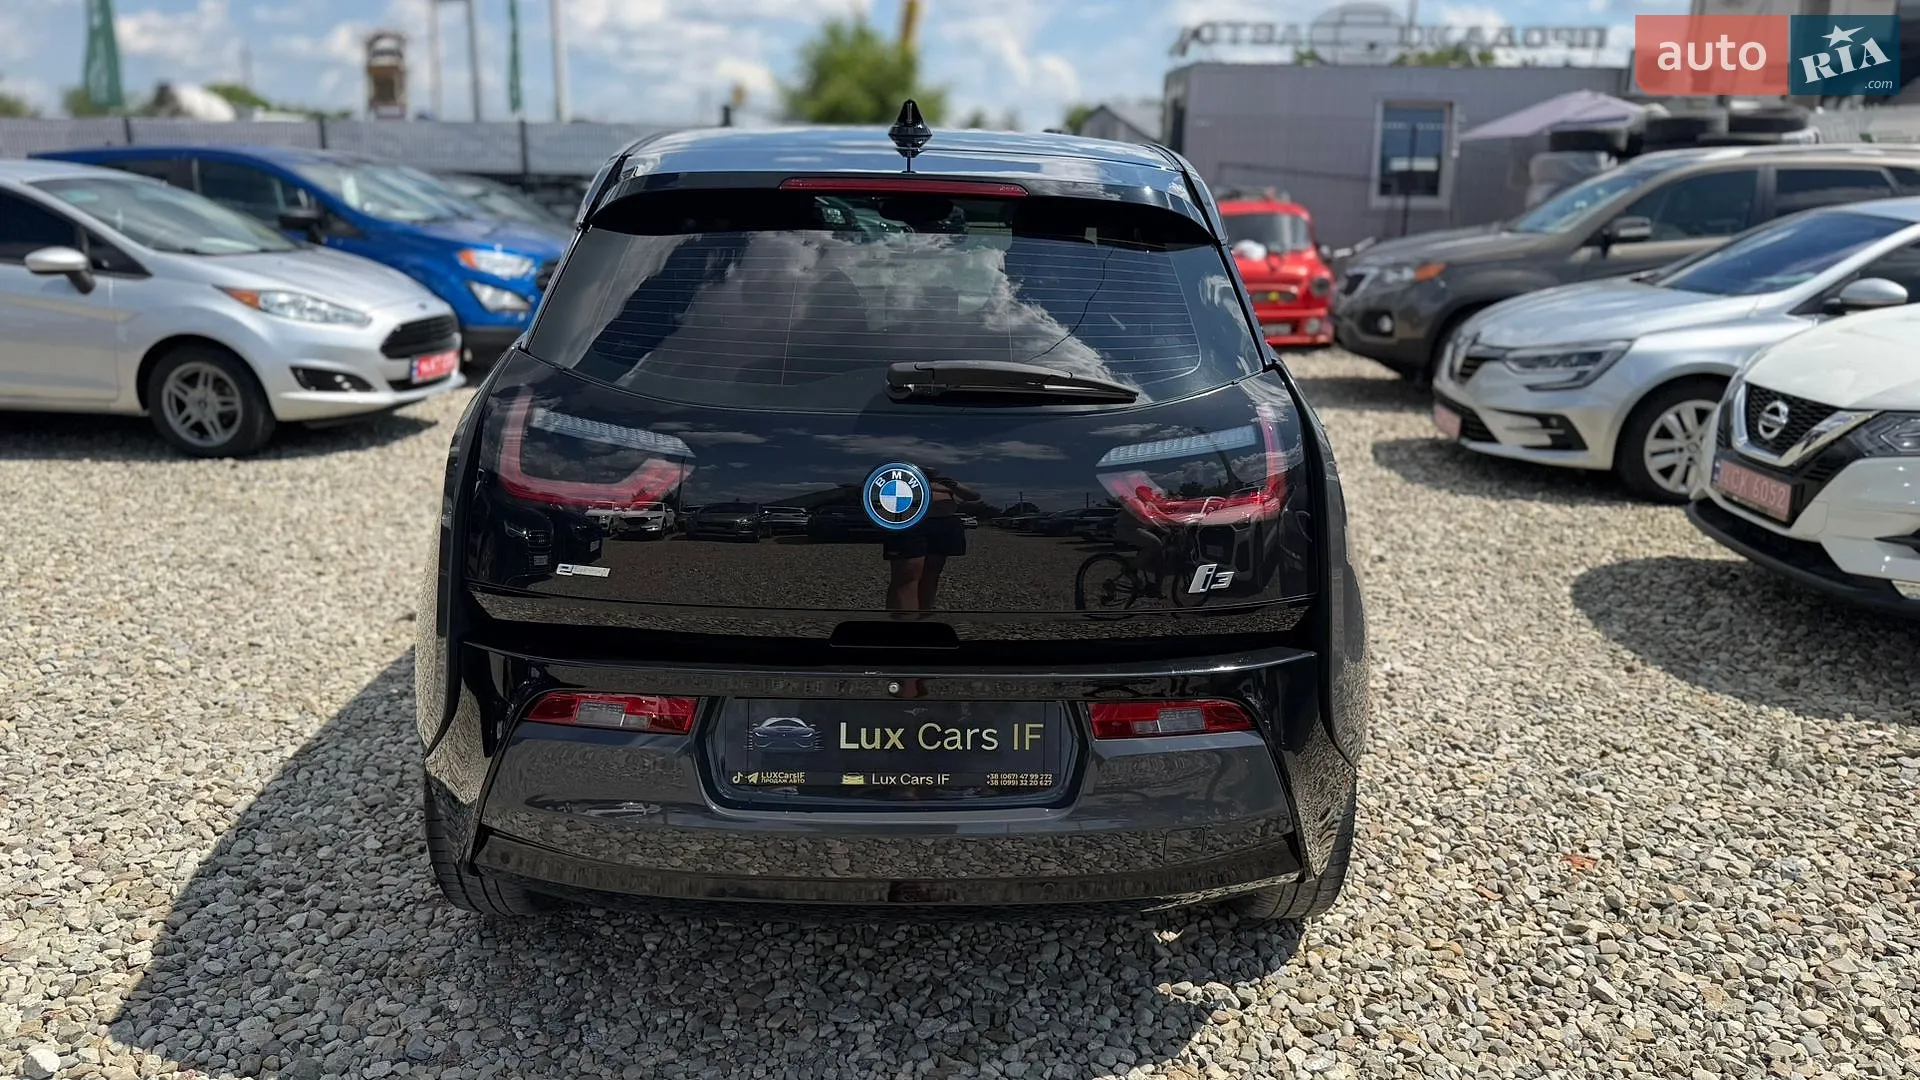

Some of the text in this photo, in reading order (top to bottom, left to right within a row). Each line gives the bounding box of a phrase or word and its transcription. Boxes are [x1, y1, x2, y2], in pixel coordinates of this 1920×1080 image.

[875, 471, 919, 489] BMW
[1753, 477, 1787, 508] 6052
[1188, 563, 1235, 593] i3
[840, 722, 1044, 750] Lux Cars IF
[761, 771, 806, 779] LUXCarsIF
[872, 773, 950, 785] Lux Cars IF
